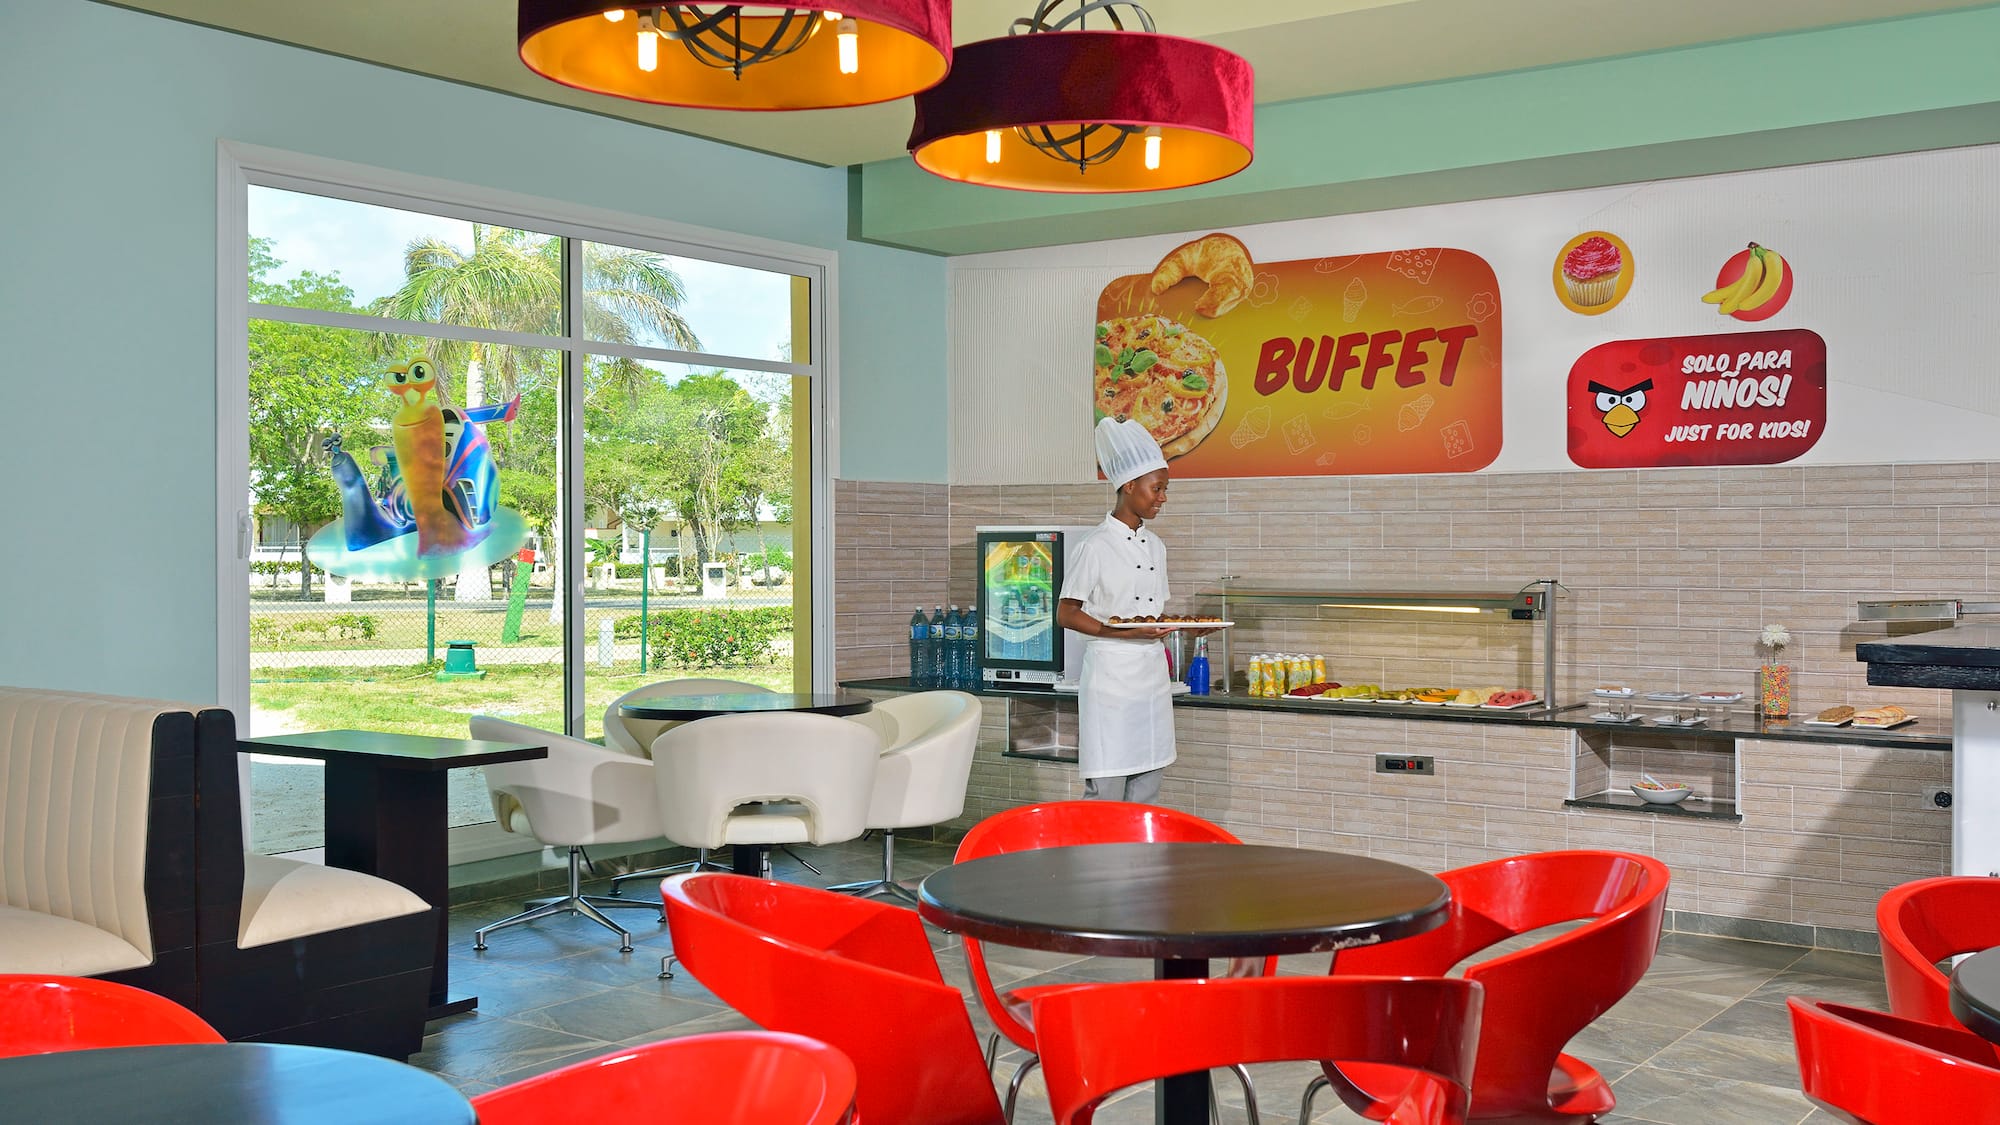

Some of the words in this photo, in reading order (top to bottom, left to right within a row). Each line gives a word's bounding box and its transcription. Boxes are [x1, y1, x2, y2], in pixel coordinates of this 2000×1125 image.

[1254, 324, 1478, 396] BUFFET
[1681, 353, 1729, 374] SOLO
[1735, 349, 1792, 371] PARA
[1680, 370, 1793, 410] NIÑOS!
[1664, 424, 1712, 443] JUST
[1716, 422, 1753, 440] FOR
[1758, 419, 1811, 439] KIDS!
